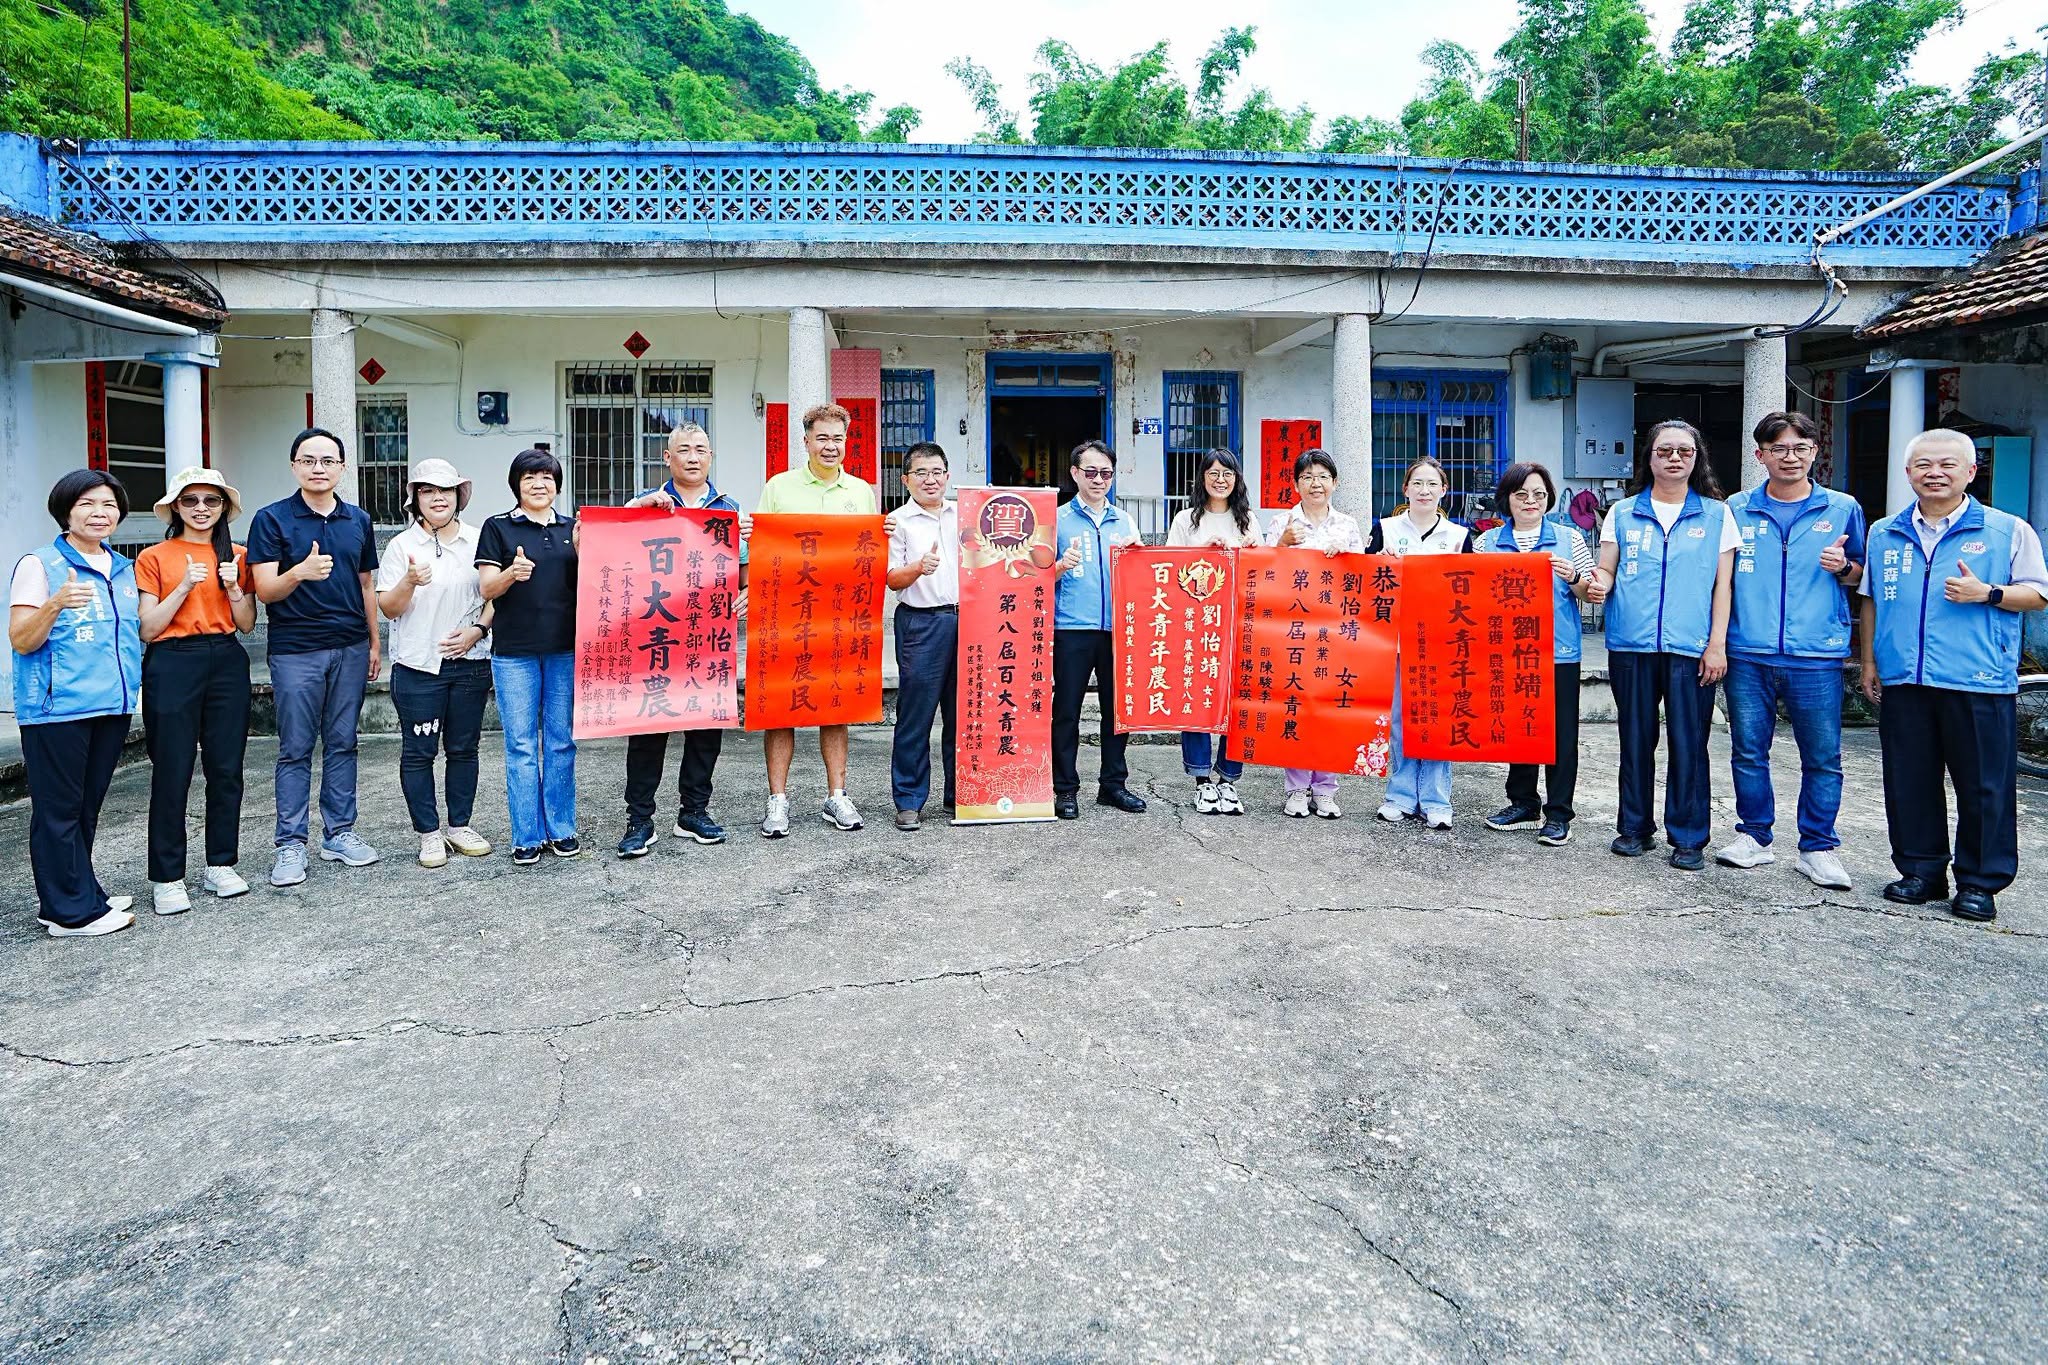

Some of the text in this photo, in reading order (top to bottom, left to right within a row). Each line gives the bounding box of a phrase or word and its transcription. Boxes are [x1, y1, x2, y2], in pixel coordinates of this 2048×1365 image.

[1147, 424, 1158, 434] 34
[703, 517, 733, 549] 賀
[986, 503, 1028, 540] 賀
[618, 561, 634, 702] 二水青年農民聯誼會
[637, 536, 682, 718] 百大青農
[684, 551, 704, 714] 榮獲農業部第八屆
[706, 552, 733, 722] 會員劉怡靖小姐
[789, 530, 823, 712] 百大青年農民
[849, 530, 880, 695] 恭賀劉怡靖女士
[1031, 586, 1044, 713] 恭賀 劉怡靖小姐 榮獲
[1125, 601, 1135, 647] 彰化縣長
[1147, 562, 1174, 716] 百大青年農民
[1314, 570, 1334, 680] 榮獲 農業部
[1334, 573, 1363, 709] 劉怡靖 女士
[1369, 566, 1400, 623] 恭賀
[1499, 576, 1530, 604] 賀
[594, 641, 606, 681] 副會長
[606, 641, 618, 681] 副會長
[997, 594, 1018, 756] 第八屆百大青農
[1181, 639, 1195, 714] 農業部第八屆
[1280, 569, 1310, 741] 第八屆百大青農
[1443, 570, 1481, 749] 百大青年農民
[1488, 616, 1505, 744] 榮獲 農業部第八屆
